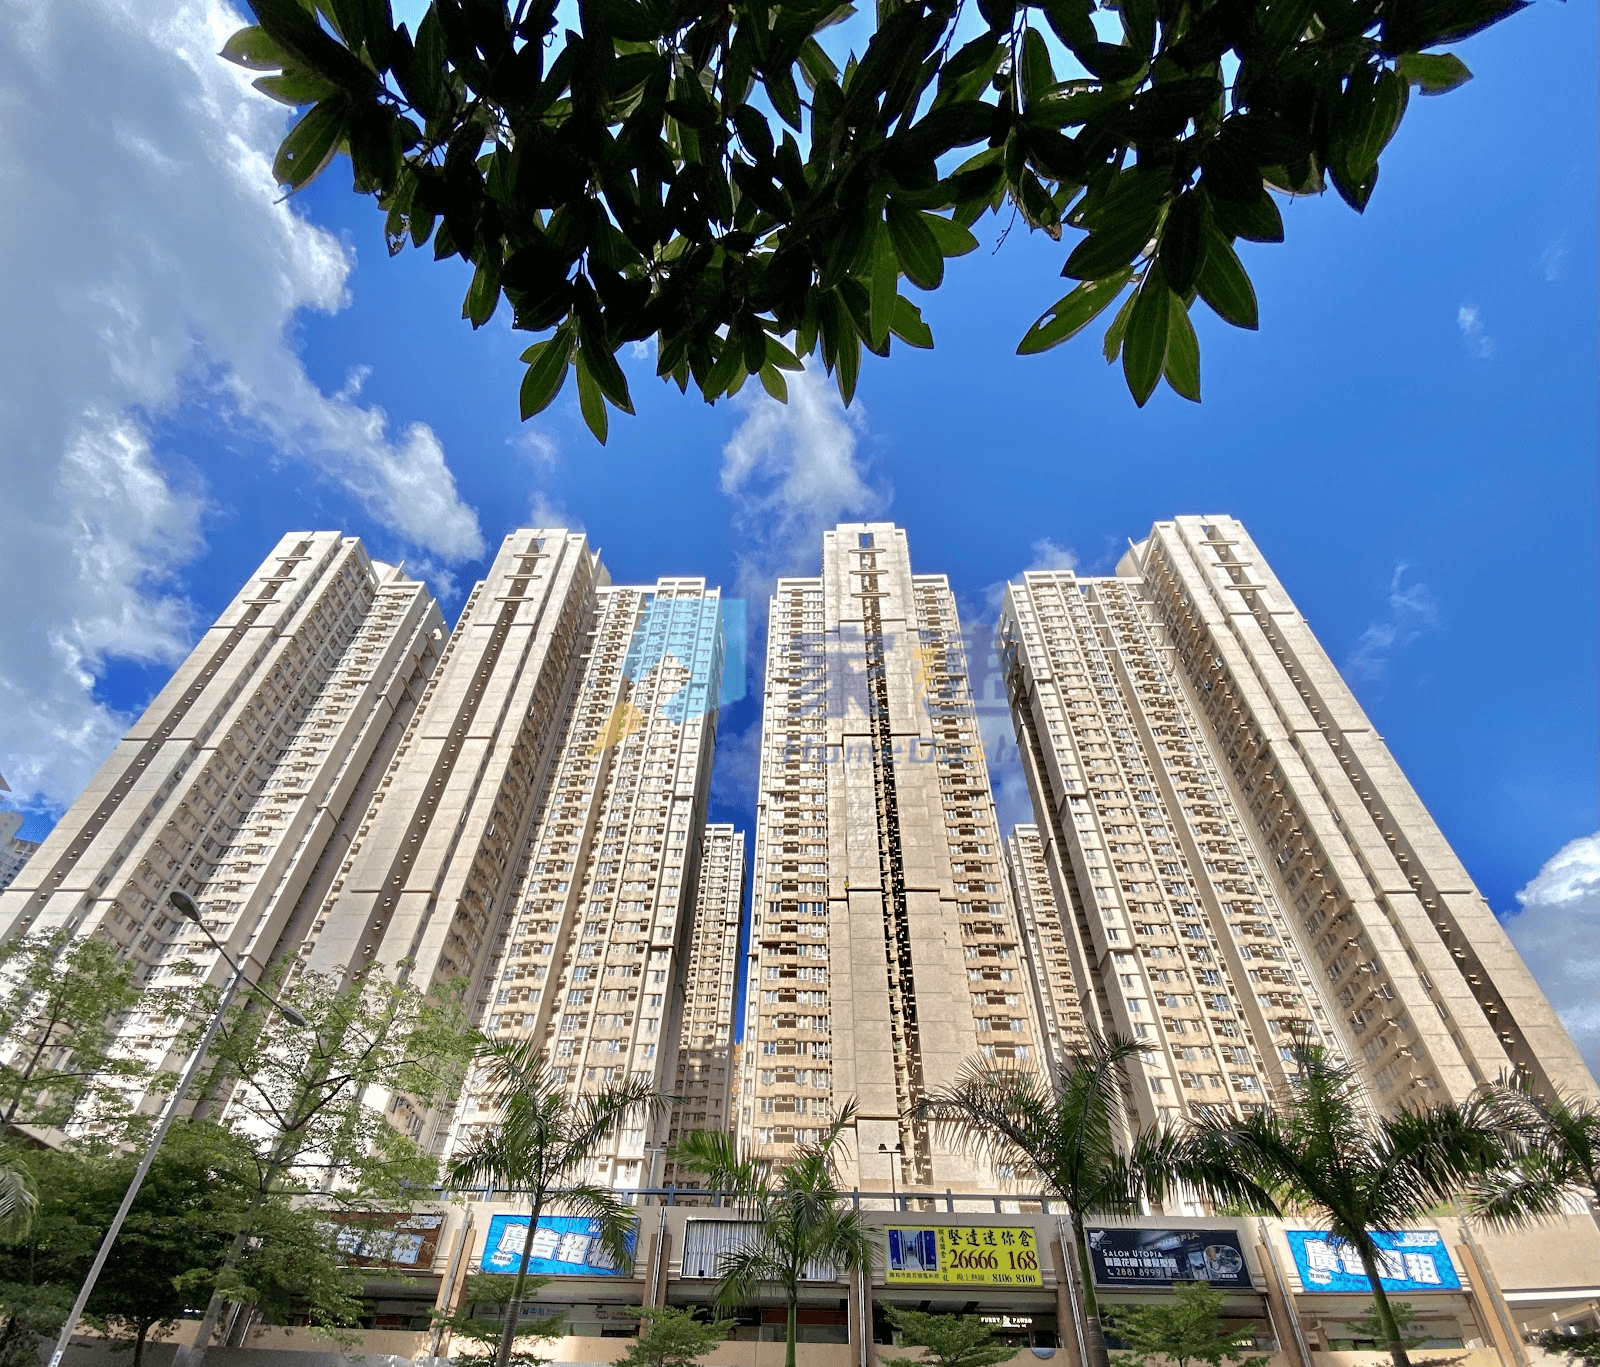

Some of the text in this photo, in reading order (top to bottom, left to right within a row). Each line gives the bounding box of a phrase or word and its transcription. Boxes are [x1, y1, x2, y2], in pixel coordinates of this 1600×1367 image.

[948, 1228, 1034, 1247] 堅達迷你倉
[1132, 1250, 1163, 1259] UTOPIA
[949, 1249, 1038, 1271] 26666 168
[1116, 1267, 1162, 1277] 2881 8999
[992, 1273, 1012, 1283] 8106
[1015, 1274, 1036, 1283] 8100
